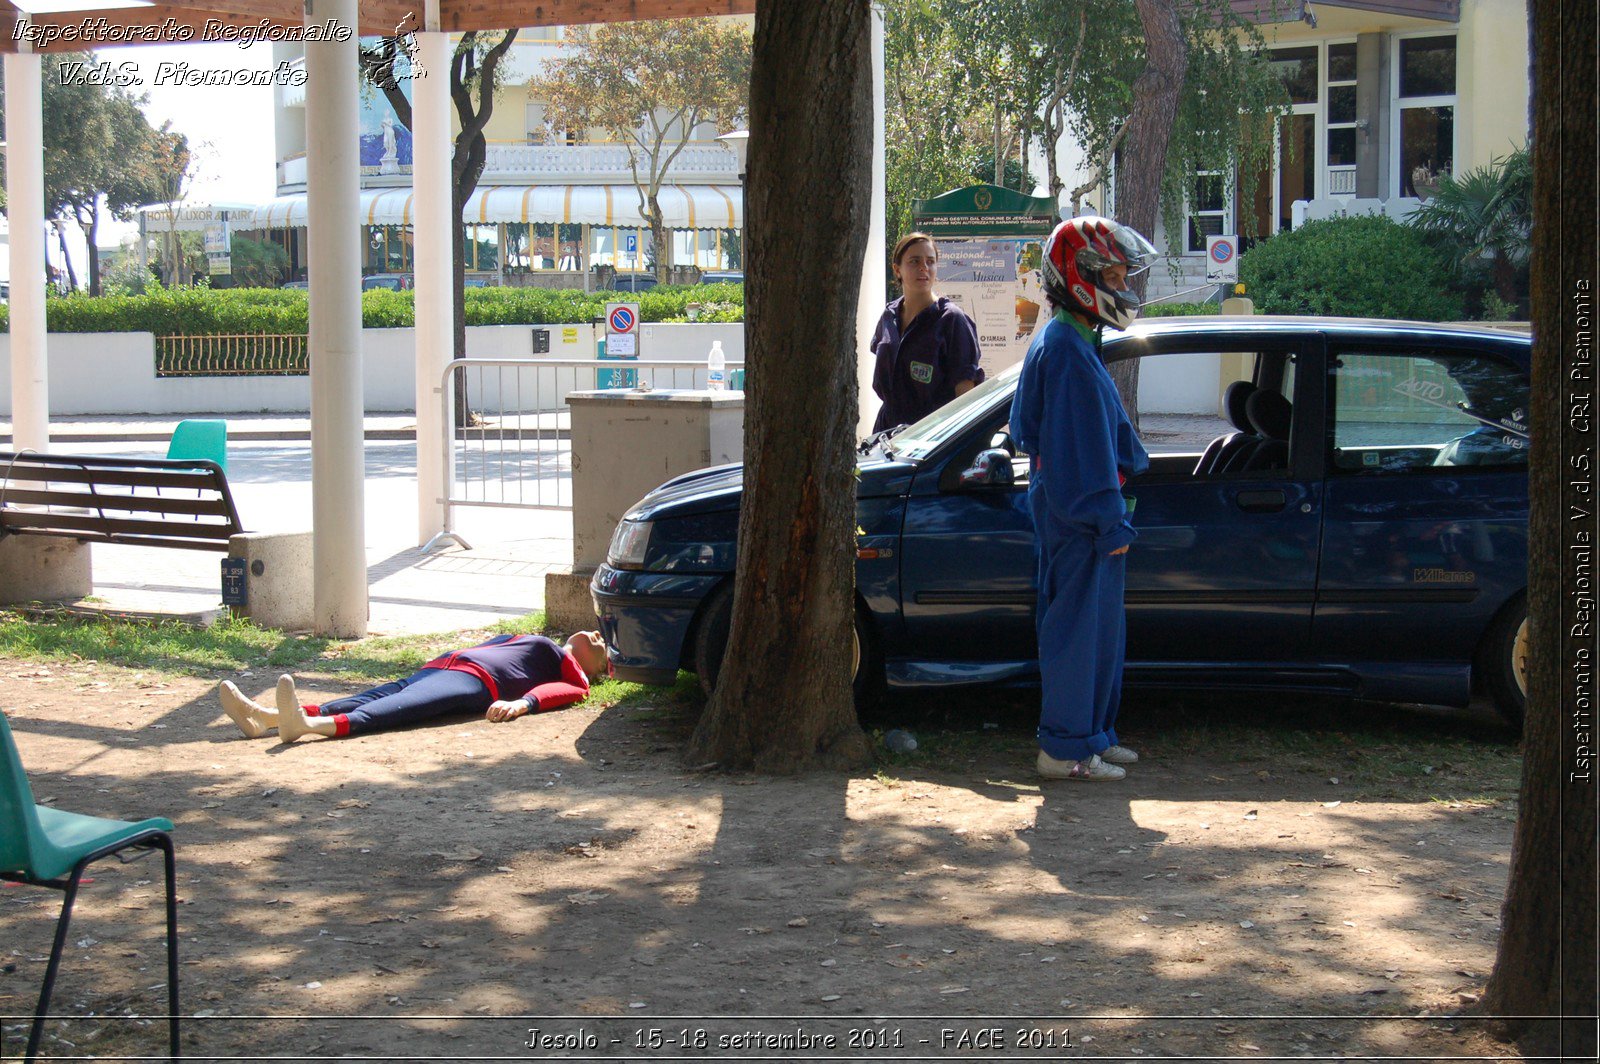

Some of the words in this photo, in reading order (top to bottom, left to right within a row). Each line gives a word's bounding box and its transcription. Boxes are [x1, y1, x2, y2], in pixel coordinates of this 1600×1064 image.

[180, 210, 212, 220] LUXOR
[628, 236, 635, 251] P
[972, 271, 1006, 282] Musica
[1500, 417, 1528, 432] RENAULT
[1413, 568, 1476, 583] Williams
